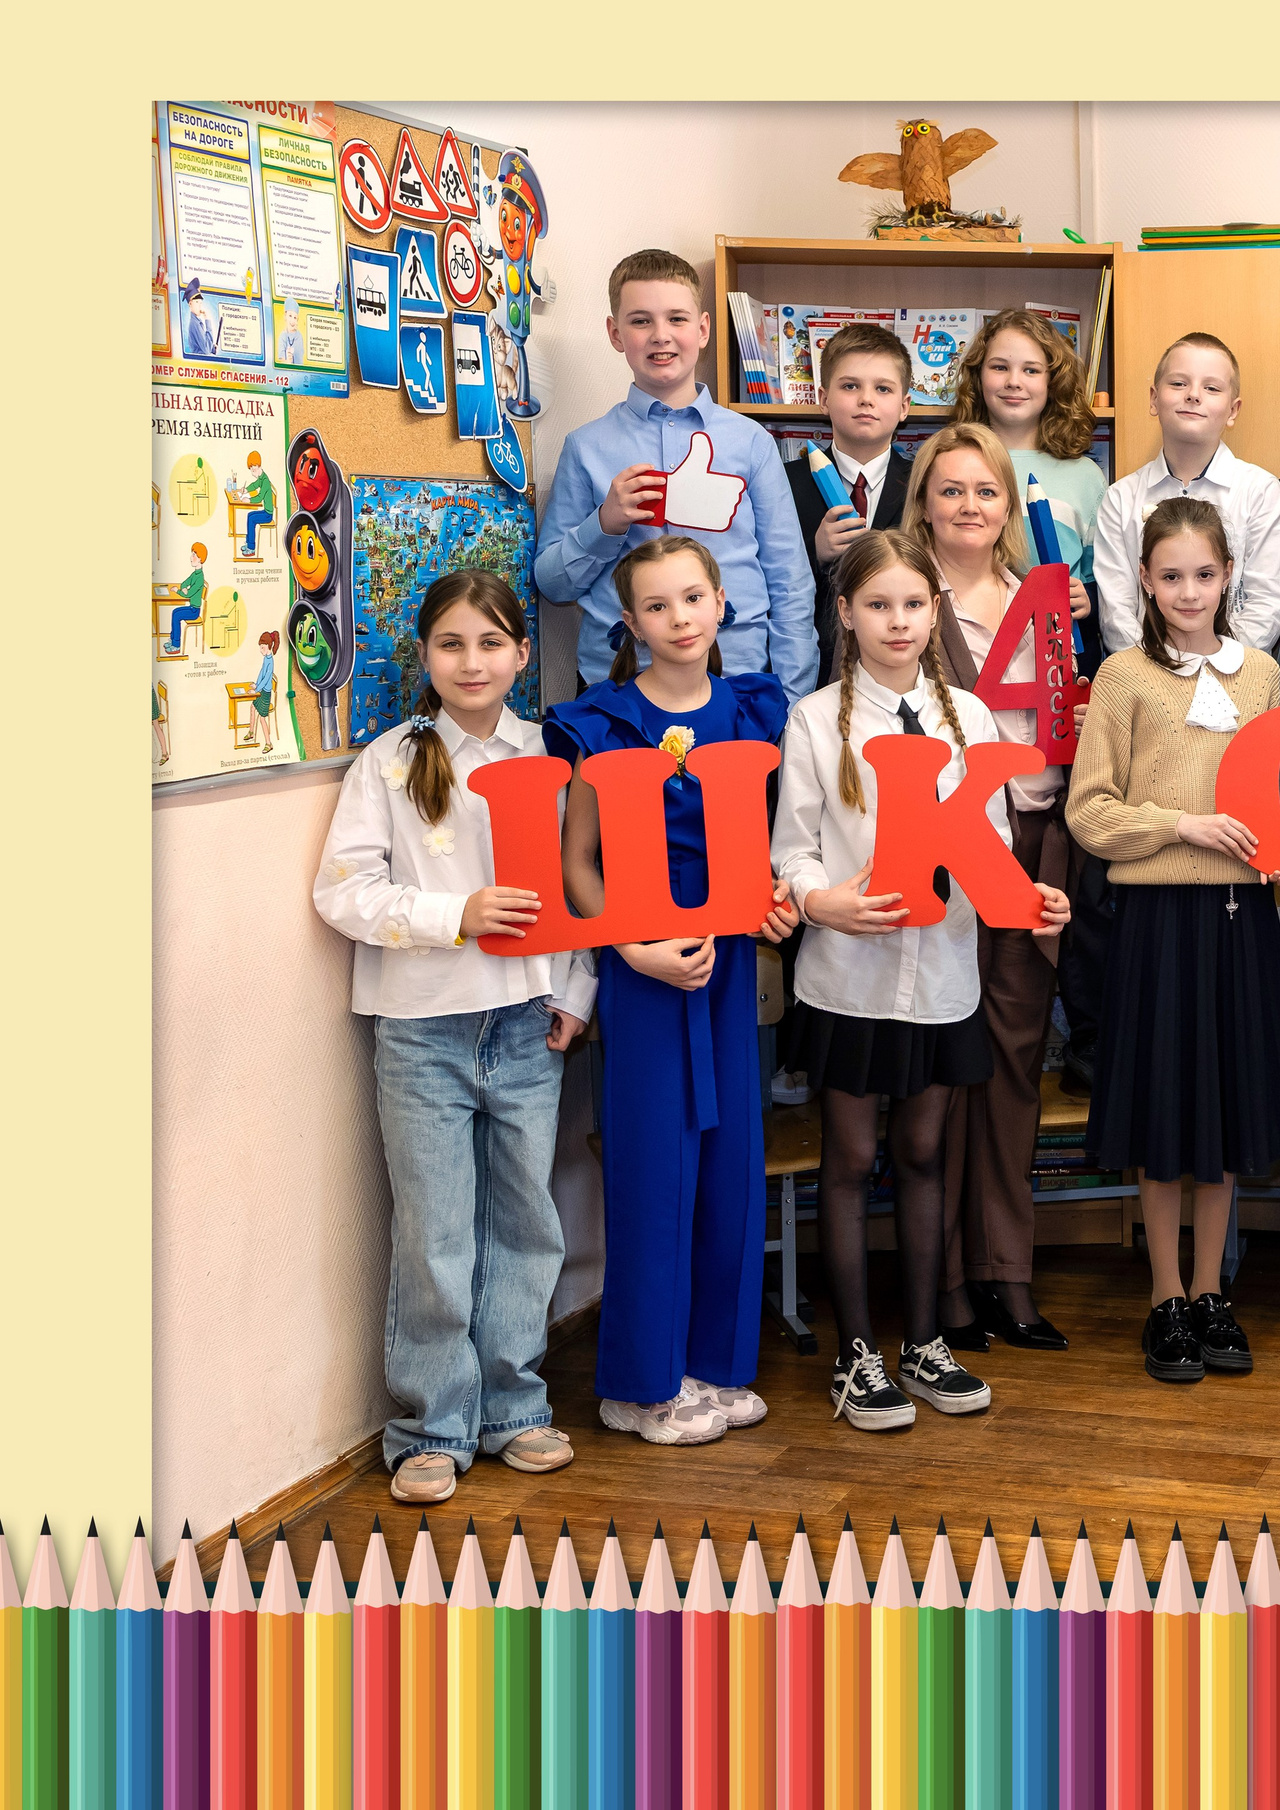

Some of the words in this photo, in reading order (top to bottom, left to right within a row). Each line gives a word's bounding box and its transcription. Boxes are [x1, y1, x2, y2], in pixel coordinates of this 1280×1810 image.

[173, 111, 243, 137] БЕЗОПАСНОСТЬ
[184, 130, 197, 141] НА
[199, 133, 234, 150] ДОРОГЕ
[279, 138, 310, 153] ЛИЧНАЯ
[215, 160, 243, 173] ПРАВИЛА
[264, 148, 327, 171] БЕЗОПАСНОСТЬ
[174, 162, 213, 176] ДОРОЖНОГО
[214, 170, 248, 183] ДВИЖЕНИЯ
[287, 176, 312, 187] ПАМЯТКА
[928, 353, 944, 362] КА
[178, 366, 218, 380] СЛУЖБЫ
[221, 371, 267, 384] СПАСЕНИЯ
[275, 377, 289, 386] 112
[207, 397, 275, 419] ПОСАДКА
[194, 420, 263, 441] ЗАНЯТИЙ
[431, 495, 456, 511] КАРТА
[457, 495, 480, 512] МИРА
[233, 568, 254, 576] Посадка
[240, 577, 260, 585] ручных
[260, 576, 280, 584] работах
[972, 563, 1092, 765] 4
[1045, 612, 1069, 740] класс
[268, 752, 291, 762] (стола)
[467, 740, 783, 957] Ш
[862, 733, 1047, 930] К
